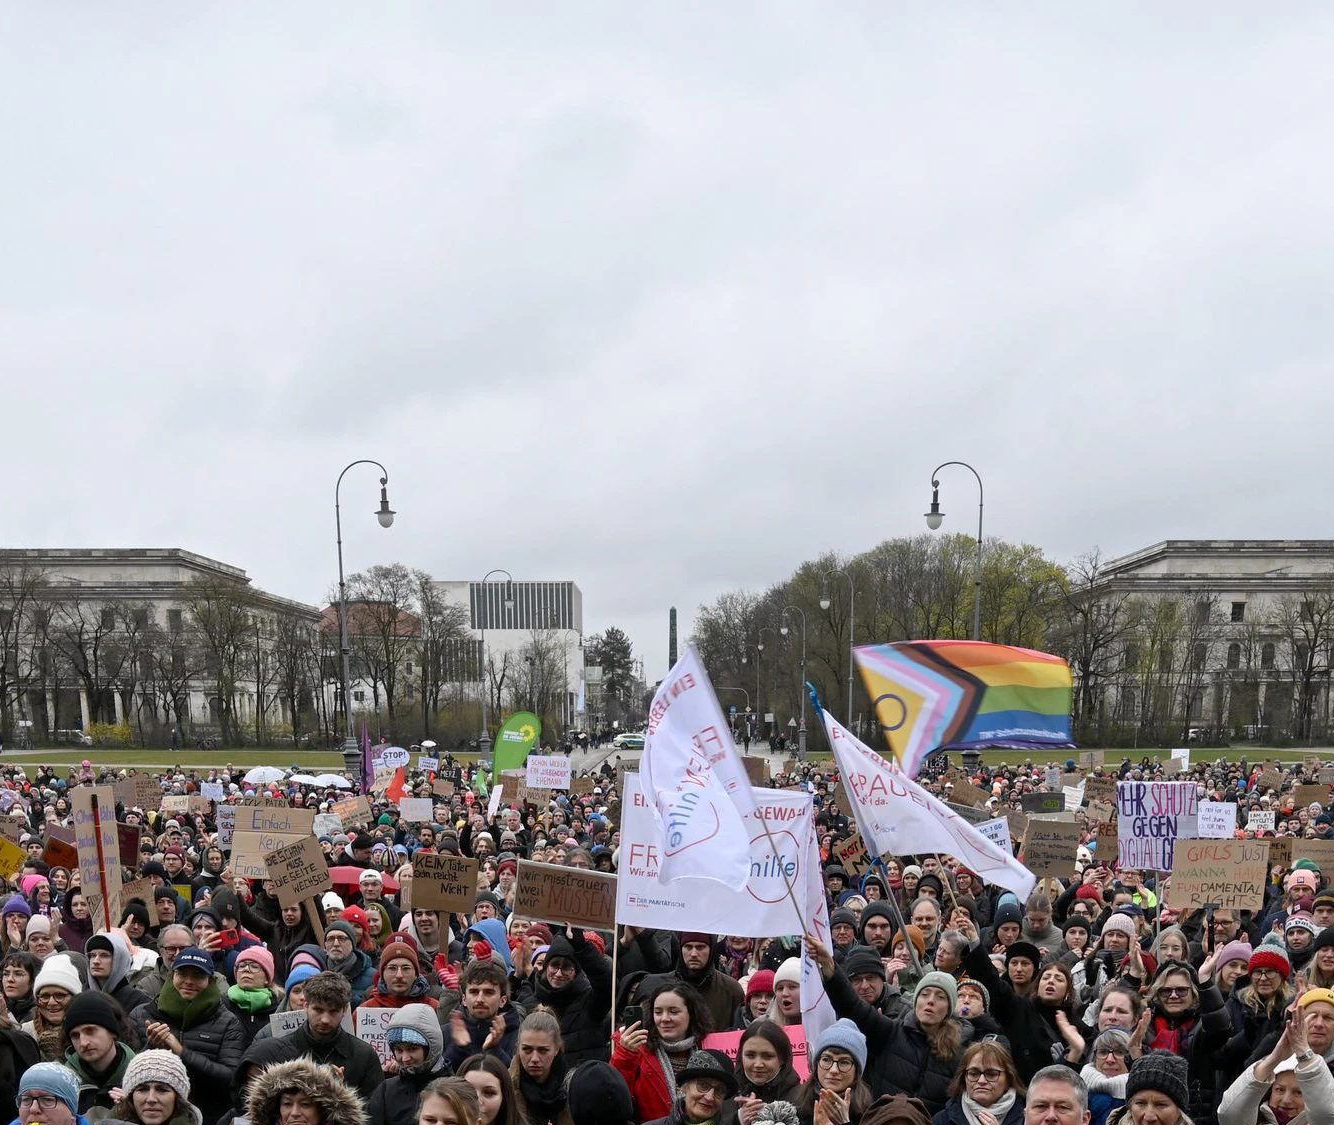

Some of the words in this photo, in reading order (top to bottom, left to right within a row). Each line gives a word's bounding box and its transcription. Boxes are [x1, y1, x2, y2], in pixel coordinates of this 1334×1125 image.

[536, 777, 562, 785] EHEMANN
[1117, 783, 1148, 817] MEHR
[1151, 783, 1197, 817] SCHUTZ
[252, 810, 291, 830] Einfach
[1133, 816, 1178, 838] GEGEN
[259, 835, 284, 851] Kein
[279, 844, 307, 863] SCHAM
[1117, 837, 1162, 868] DIGITALE
[1187, 845, 1233, 862] GIRLS
[1234, 844, 1267, 864] JUST
[286, 857, 305, 872] MUSS
[416, 855, 447, 870] KEIN
[275, 874, 289, 888] DIE
[289, 863, 318, 883] SEITE
[434, 871, 459, 881] reicht
[630, 868, 644, 876] Wir
[1178, 867, 1227, 878] WANNA
[1233, 867, 1267, 880] HAVE
[292, 872, 331, 894] WECHSELN
[544, 872, 612, 893] misstrauen
[1177, 881, 1262, 896] FUNDAMENTAL
[548, 885, 615, 918] MÜSSEN
[648, 898, 685, 909] PARITÄTISCHE
[1191, 894, 1258, 907] RIGHTS
[282, 1021, 296, 1031] du
[361, 1014, 376, 1026] die
